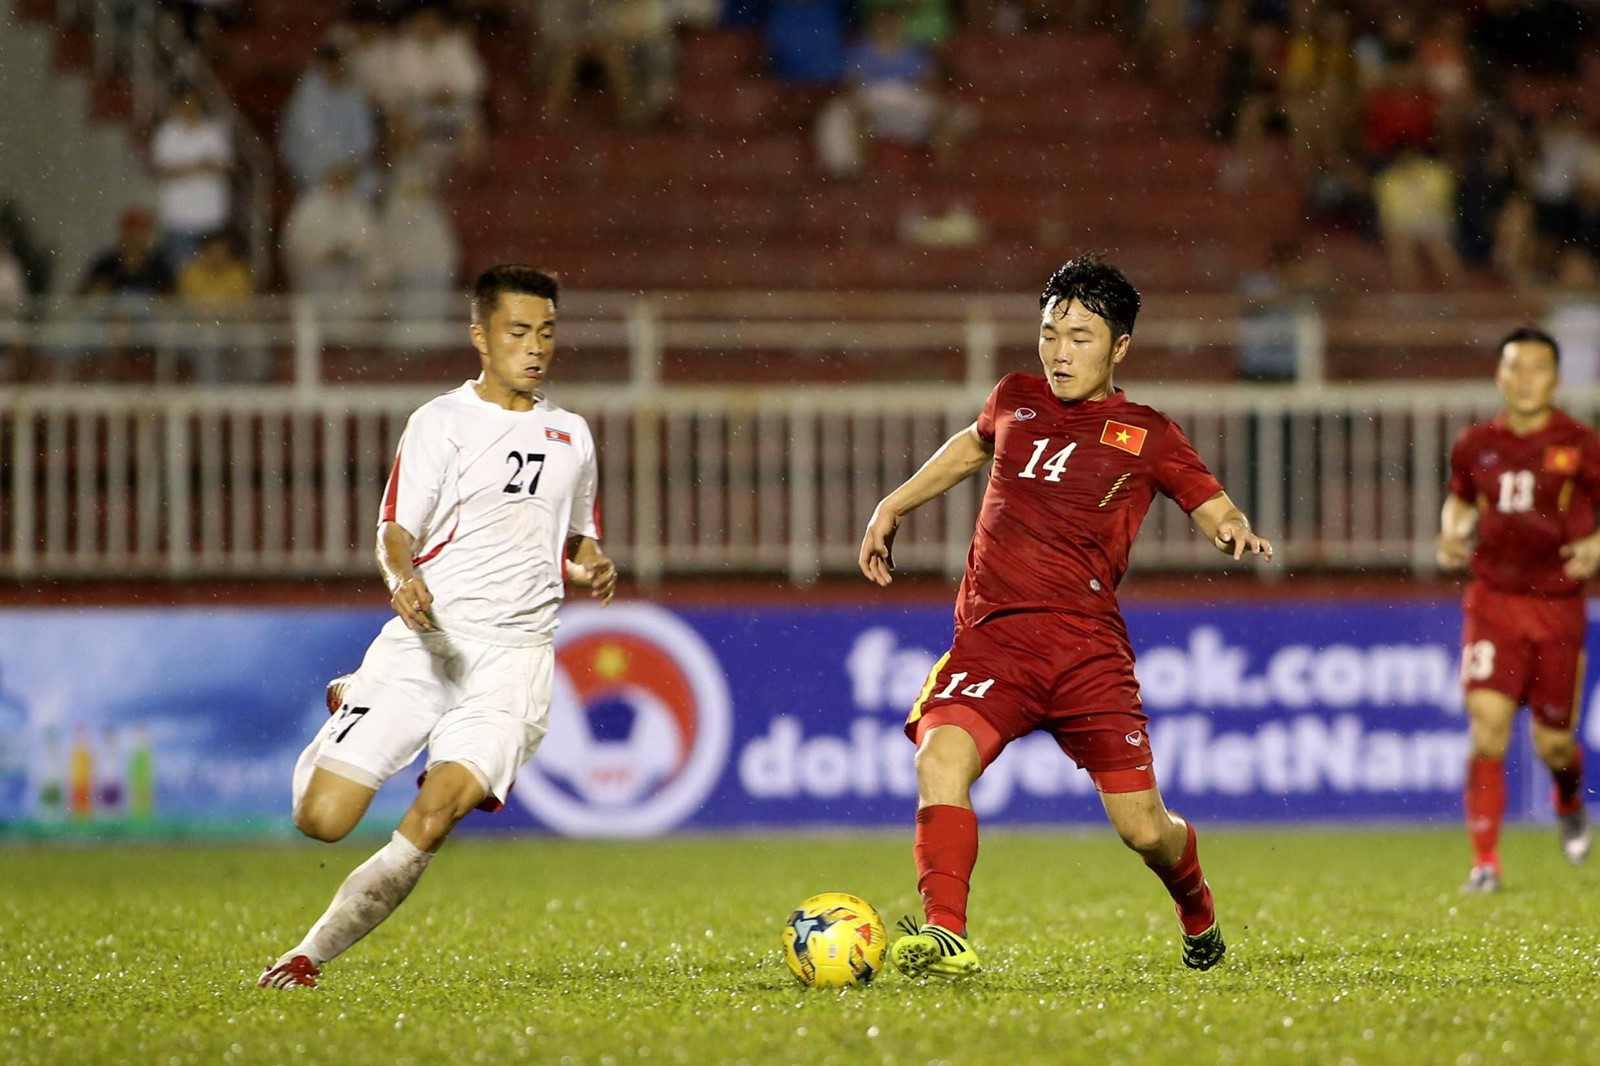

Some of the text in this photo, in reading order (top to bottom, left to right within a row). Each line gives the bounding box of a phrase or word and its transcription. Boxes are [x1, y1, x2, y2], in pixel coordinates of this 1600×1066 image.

[502, 450, 546, 495] 27
[1018, 438, 1077, 482] 14
[1497, 469, 1535, 513] 13
